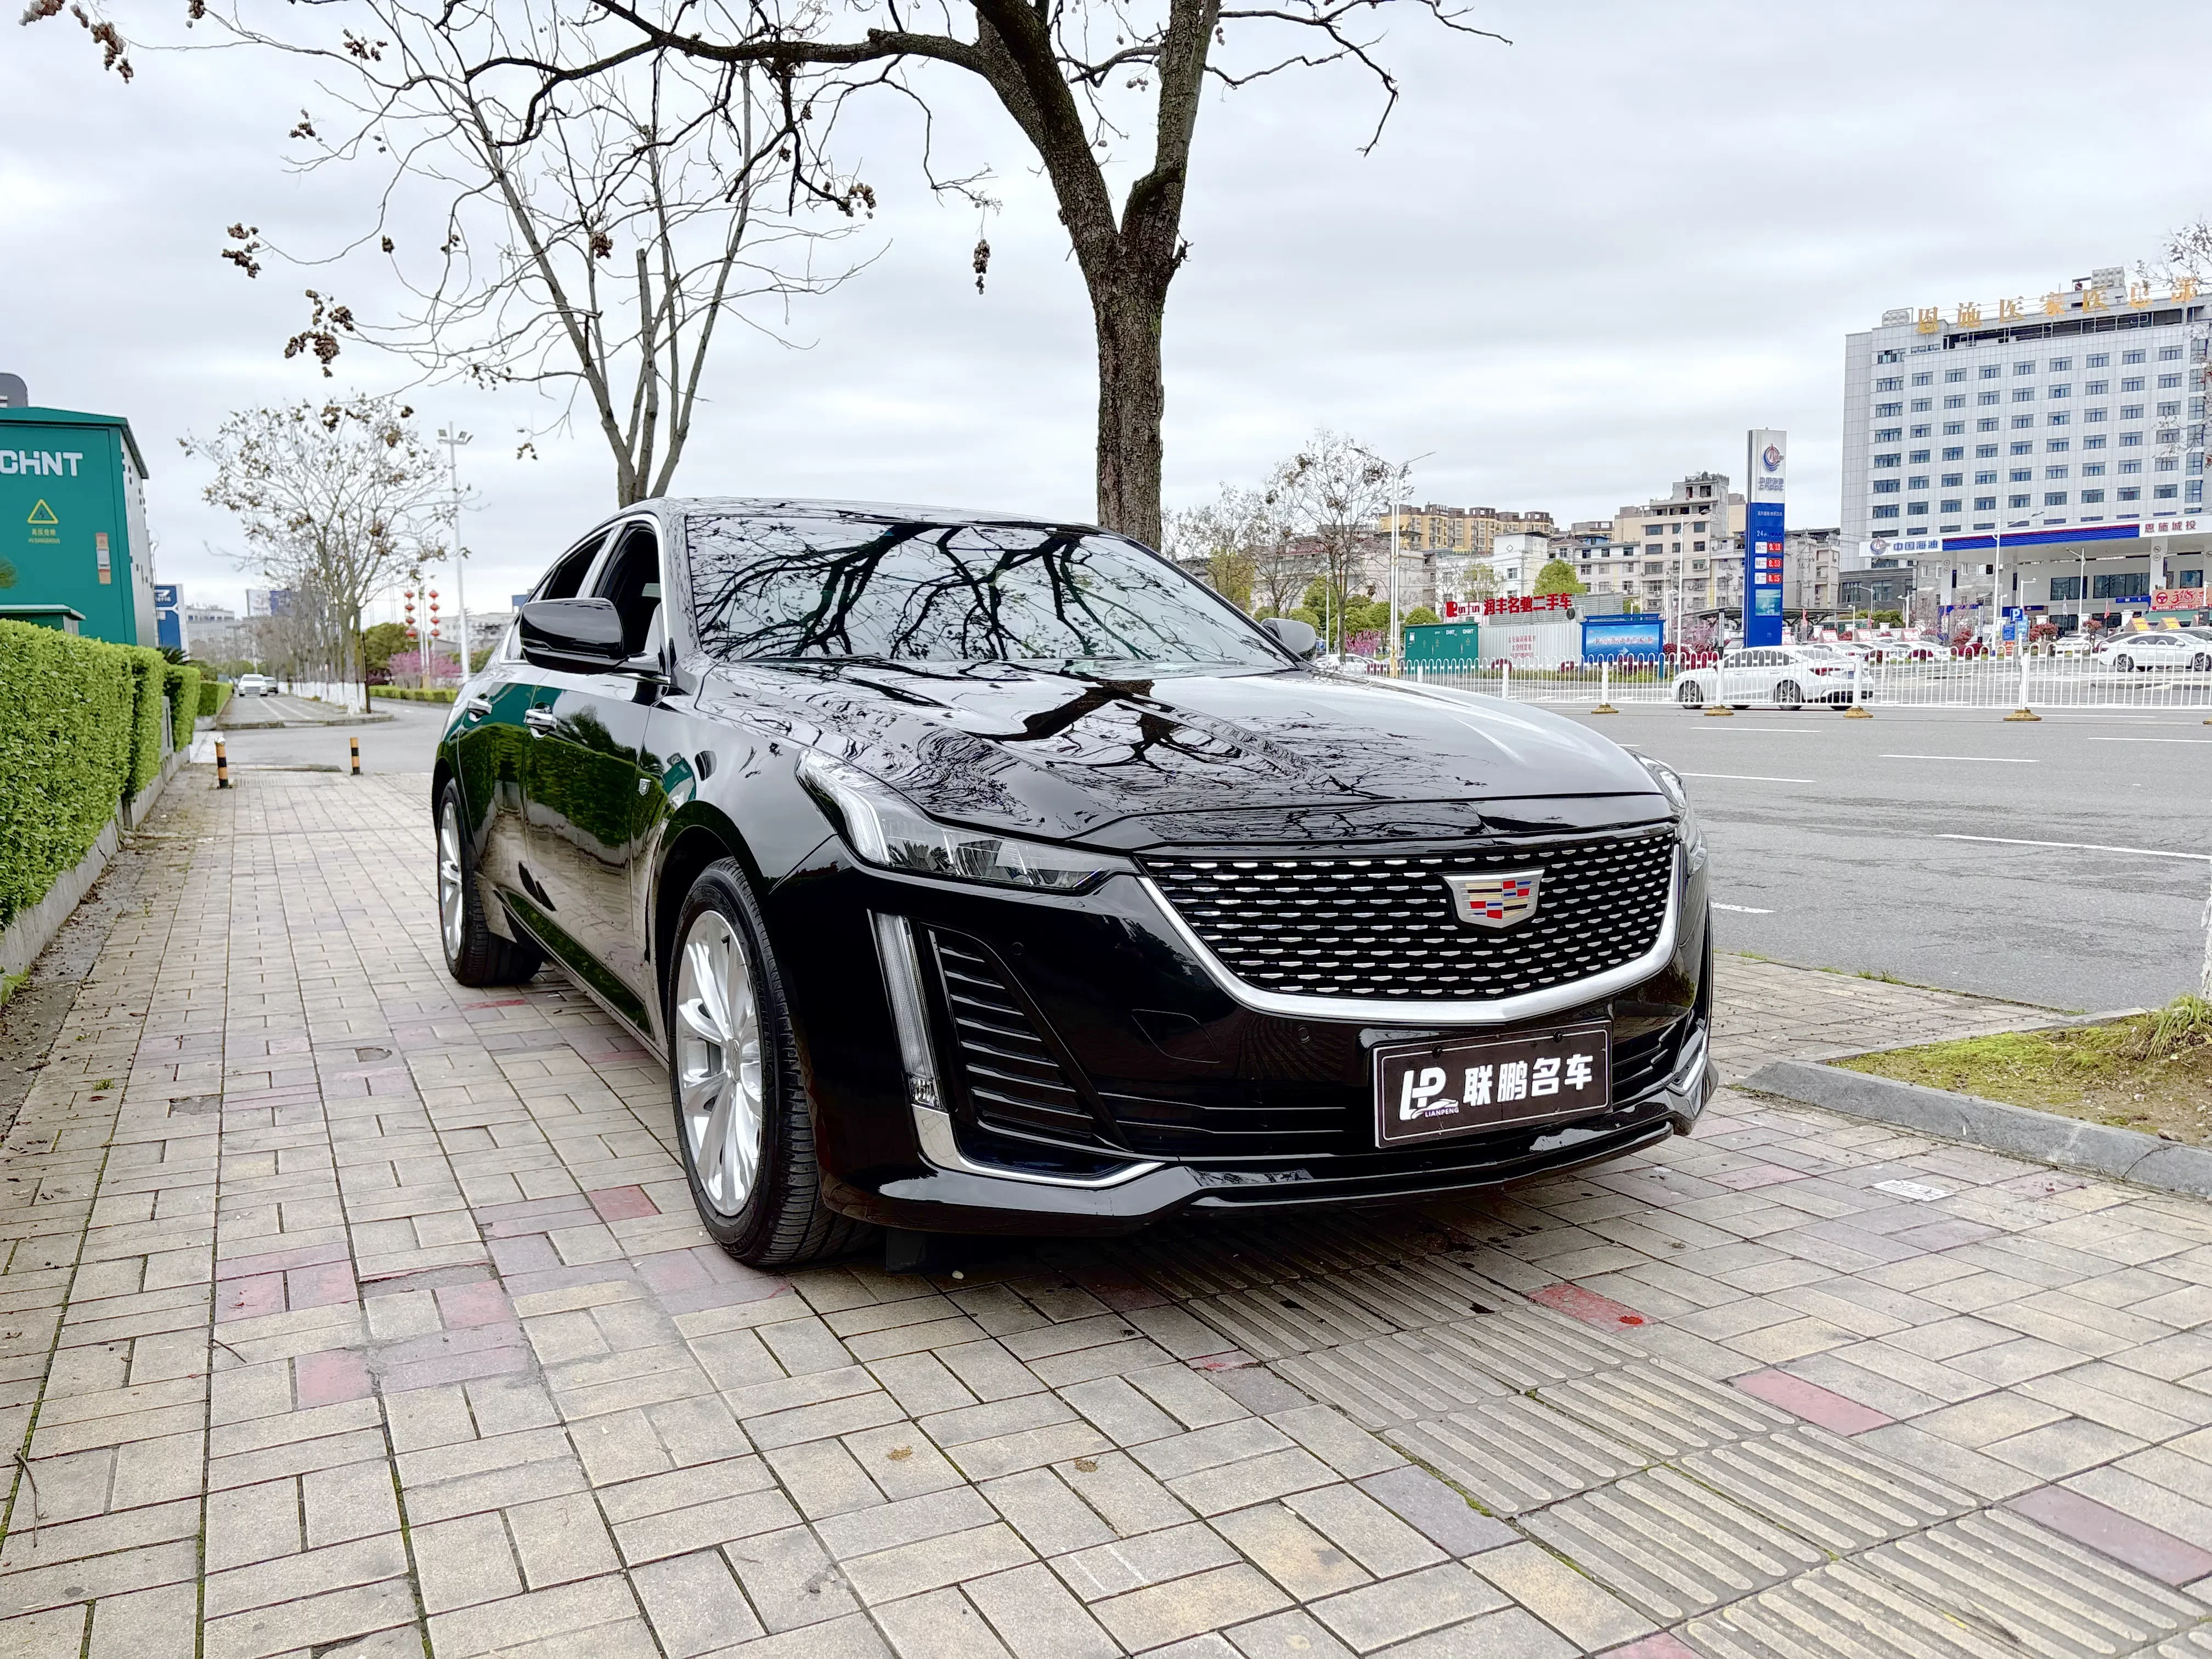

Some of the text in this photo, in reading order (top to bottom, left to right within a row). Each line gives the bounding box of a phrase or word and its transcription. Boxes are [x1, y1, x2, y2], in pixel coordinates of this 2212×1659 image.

[0, 450, 83, 477] CHNT
[2145, 520, 2196, 533] 恩施城投
[1893, 540, 1938, 551] 中国海油
[1483, 592, 1572, 616] 润丰名驰二手车
[2012, 608, 2020, 621] P
[1463, 1053, 1593, 1107] 联鹏名车
[1425, 1107, 1459, 1118] LIANPENG
